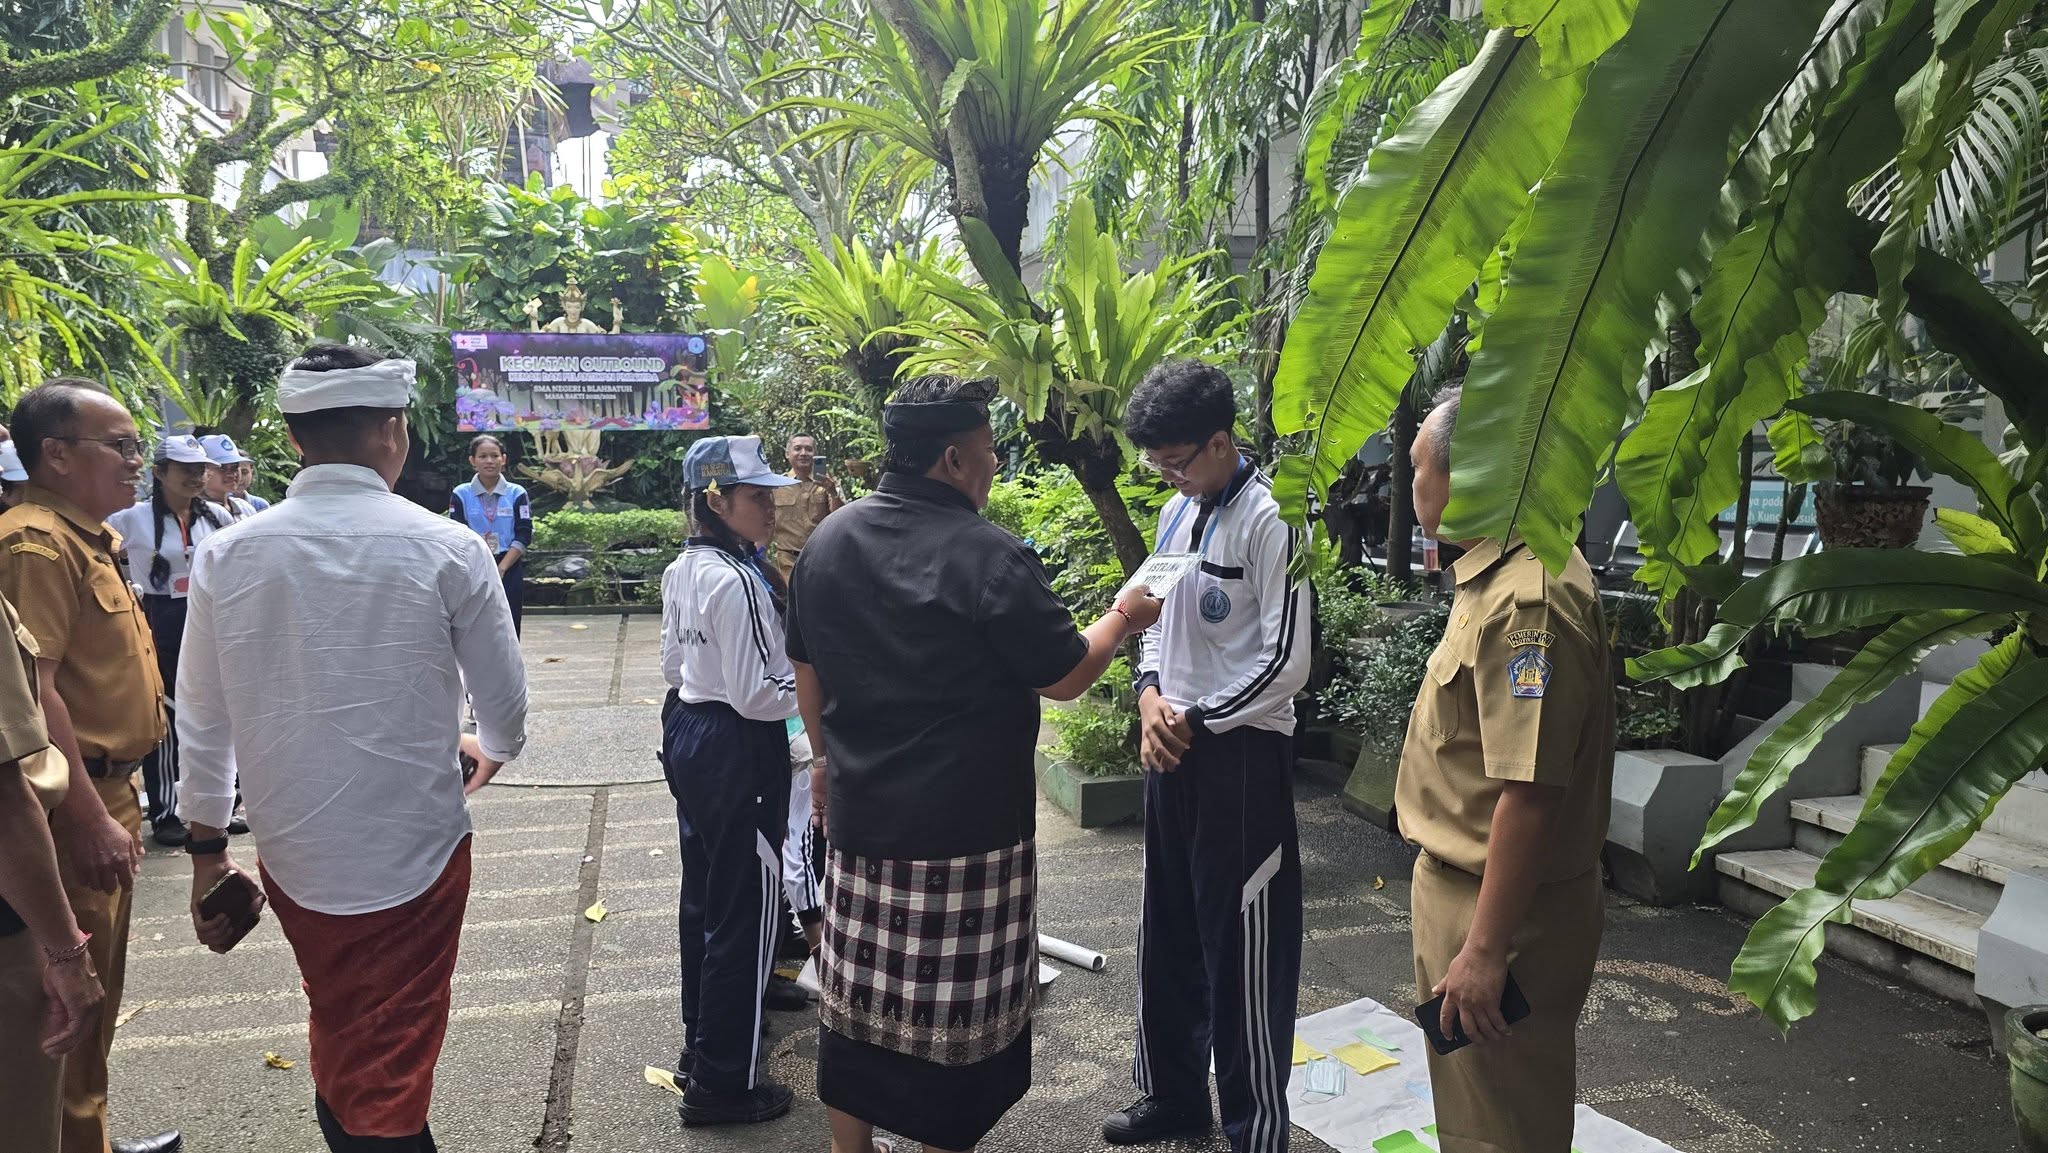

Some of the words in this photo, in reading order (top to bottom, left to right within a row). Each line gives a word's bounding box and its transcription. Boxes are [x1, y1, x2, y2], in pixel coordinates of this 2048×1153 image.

[500, 356, 579, 372] KEGIATAN
[580, 357, 666, 373] OUTBOUND
[542, 373, 562, 382] DAN
[533, 385, 551, 393] SMA
[552, 385, 581, 393] NEGERI
[587, 385, 633, 393] BLAHBATUH
